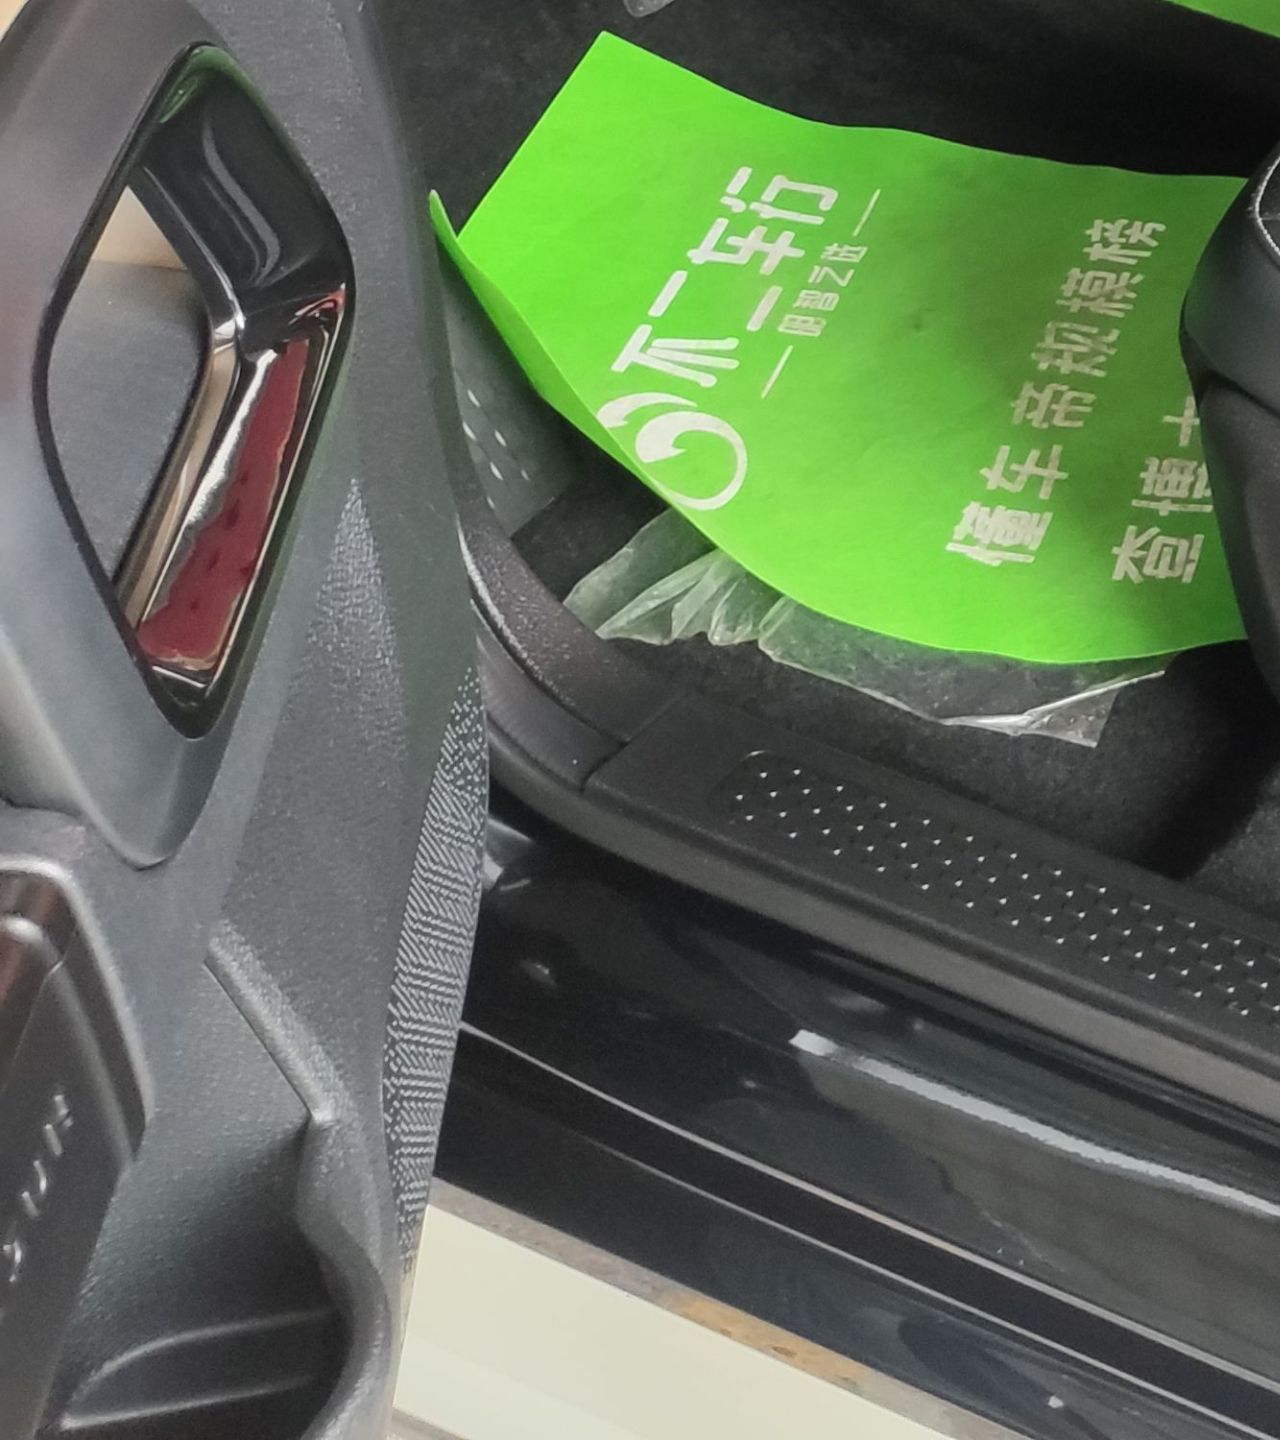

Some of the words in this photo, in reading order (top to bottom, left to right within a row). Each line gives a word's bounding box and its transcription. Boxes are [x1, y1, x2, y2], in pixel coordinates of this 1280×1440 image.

[945, 217, 1167, 568] 懂车帝规模榜
